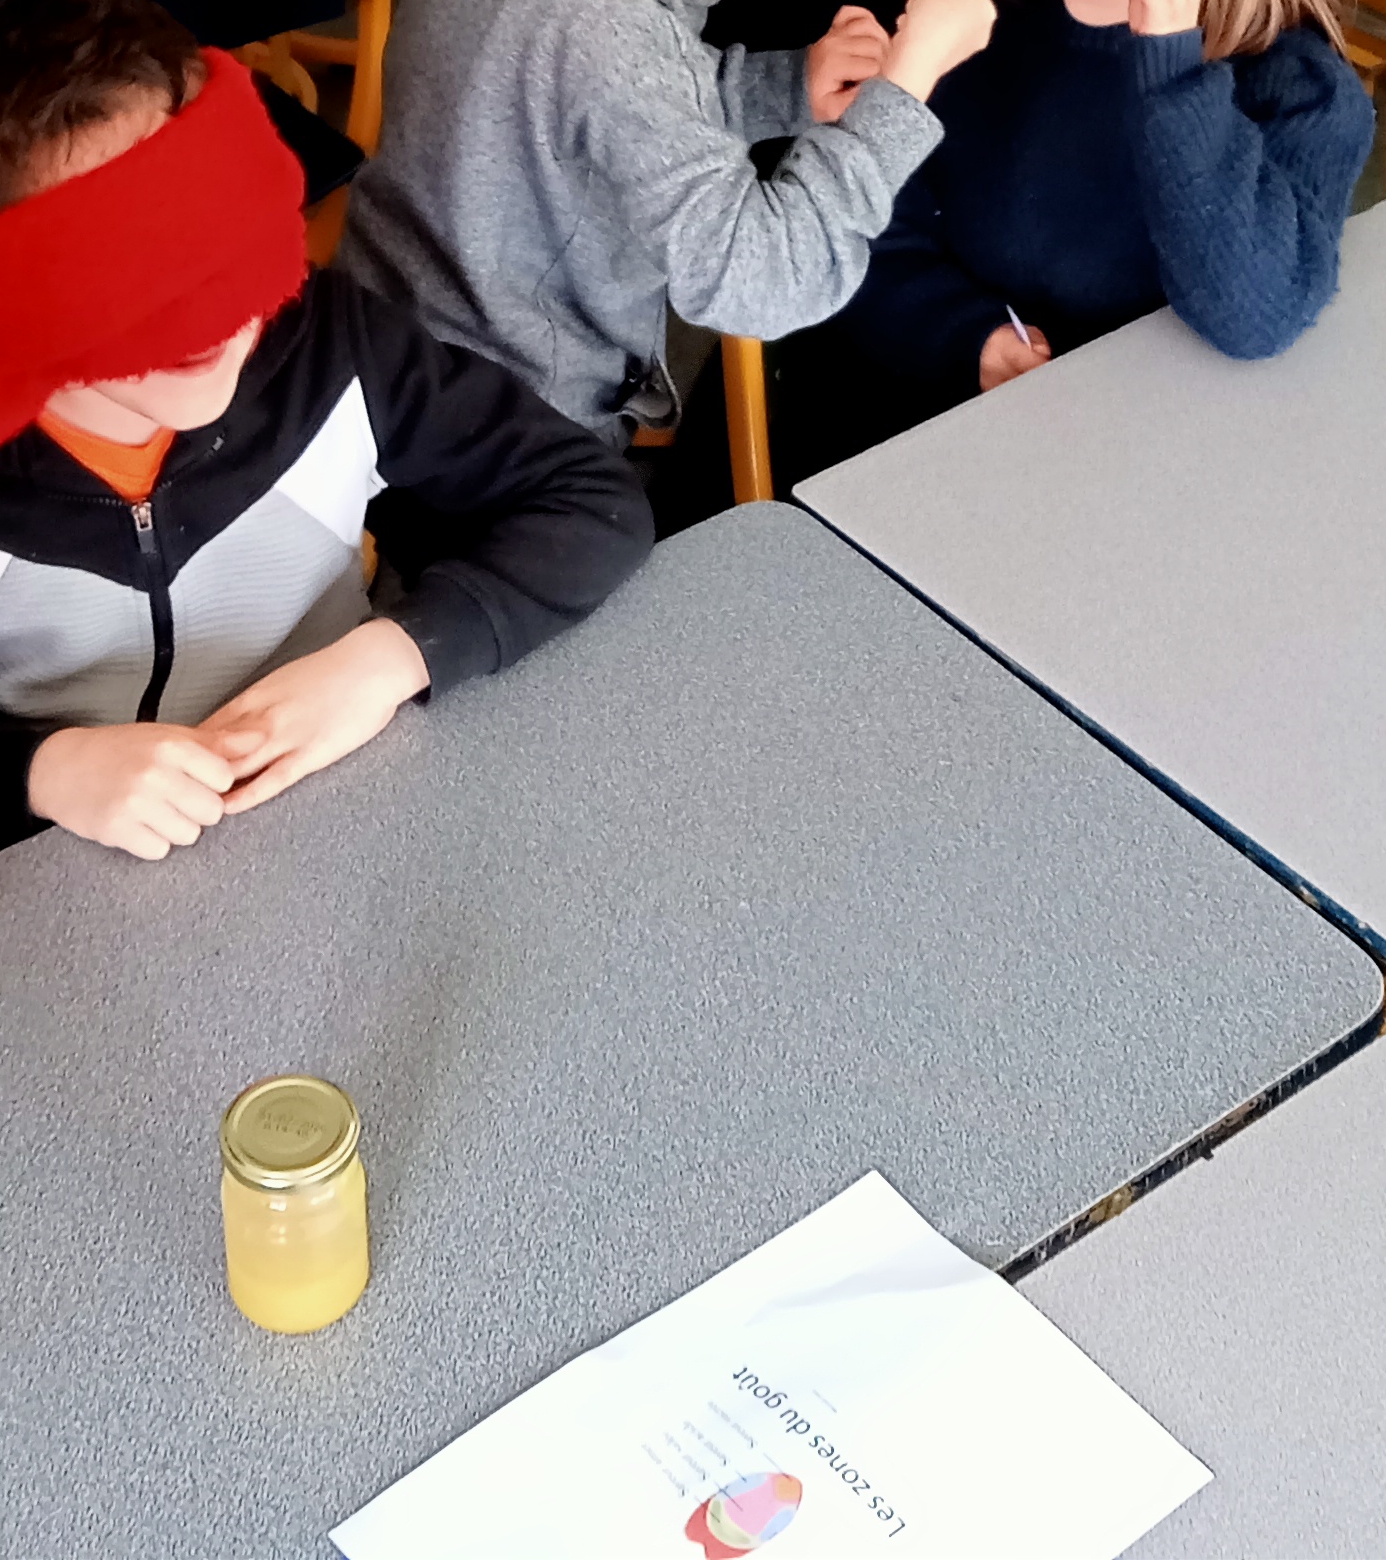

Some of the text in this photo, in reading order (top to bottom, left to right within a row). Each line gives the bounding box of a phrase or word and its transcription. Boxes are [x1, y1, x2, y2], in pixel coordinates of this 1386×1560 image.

[732, 1364, 788, 1409] goût
[779, 1407, 811, 1435] du
[808, 1434, 871, 1496] zones
[868, 1495, 906, 1538] Les
